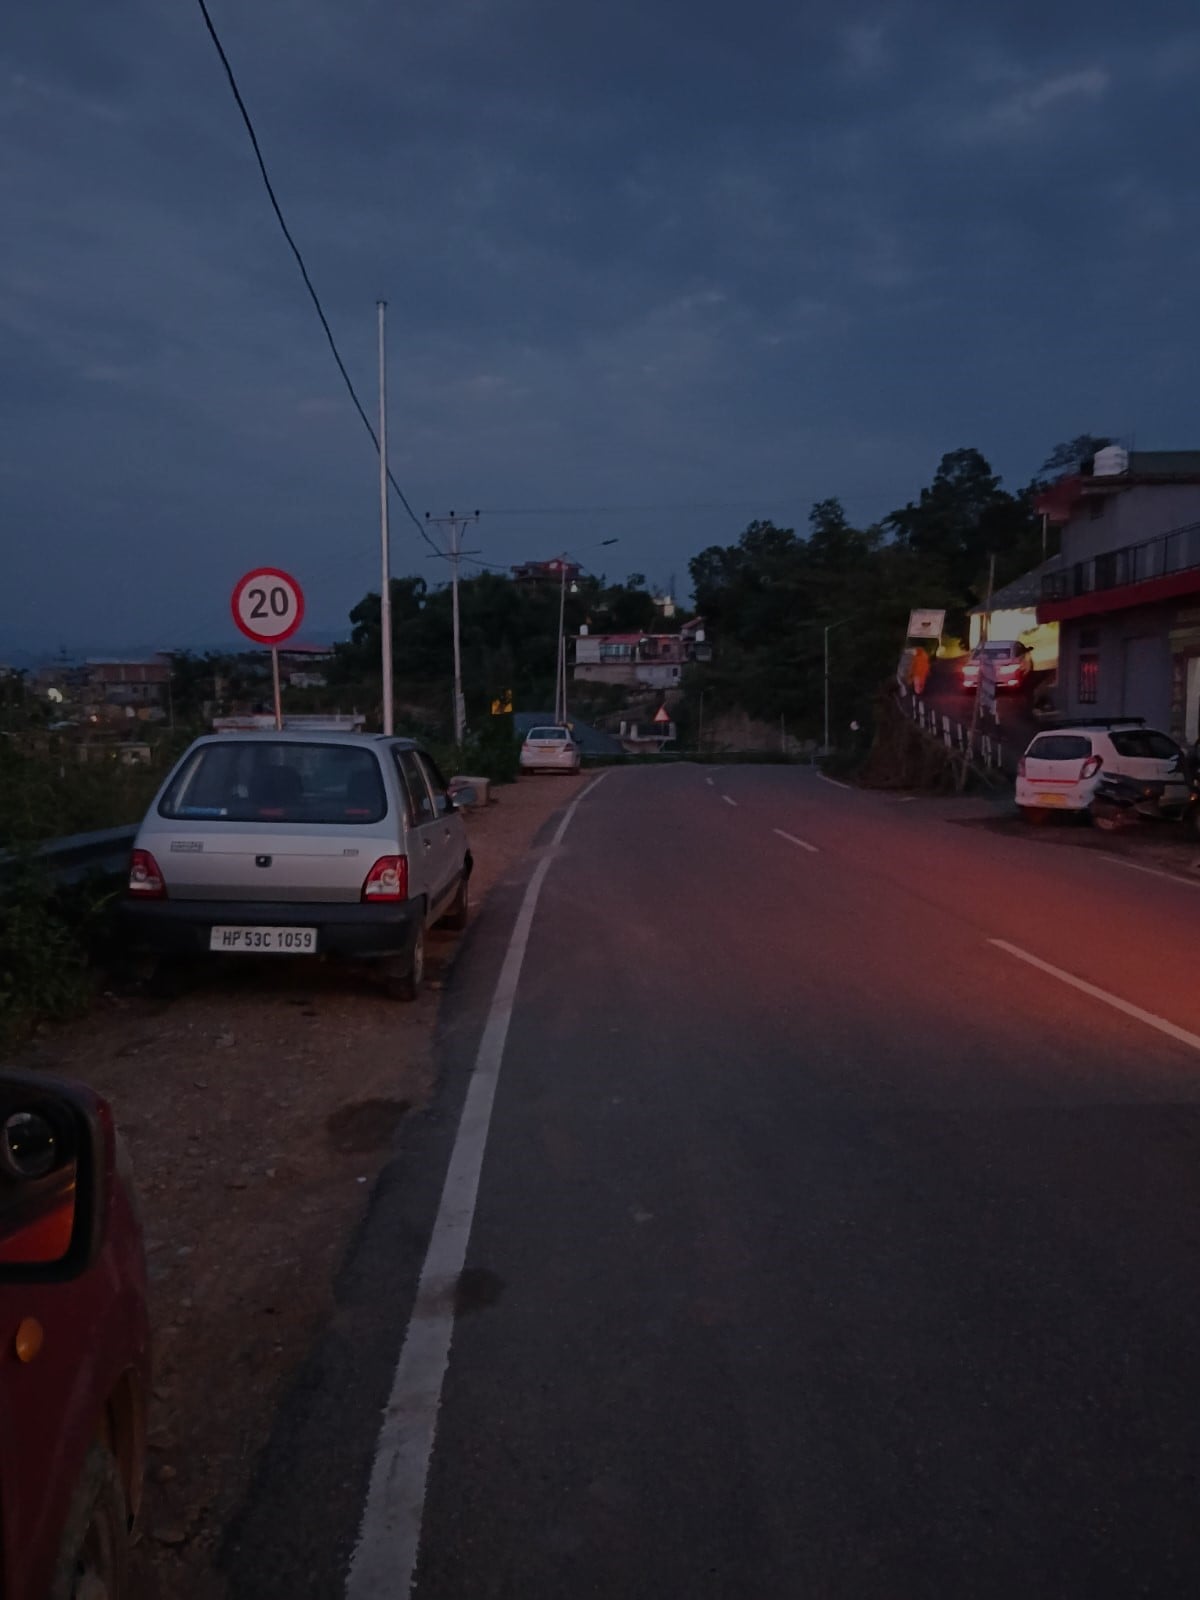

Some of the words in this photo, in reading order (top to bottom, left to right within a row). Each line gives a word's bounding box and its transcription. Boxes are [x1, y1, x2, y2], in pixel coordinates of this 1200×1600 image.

[248, 587, 289, 618] 20
[223, 930, 241, 946] HP
[244, 931, 271, 947] 53C
[278, 932, 312, 948] 1059
